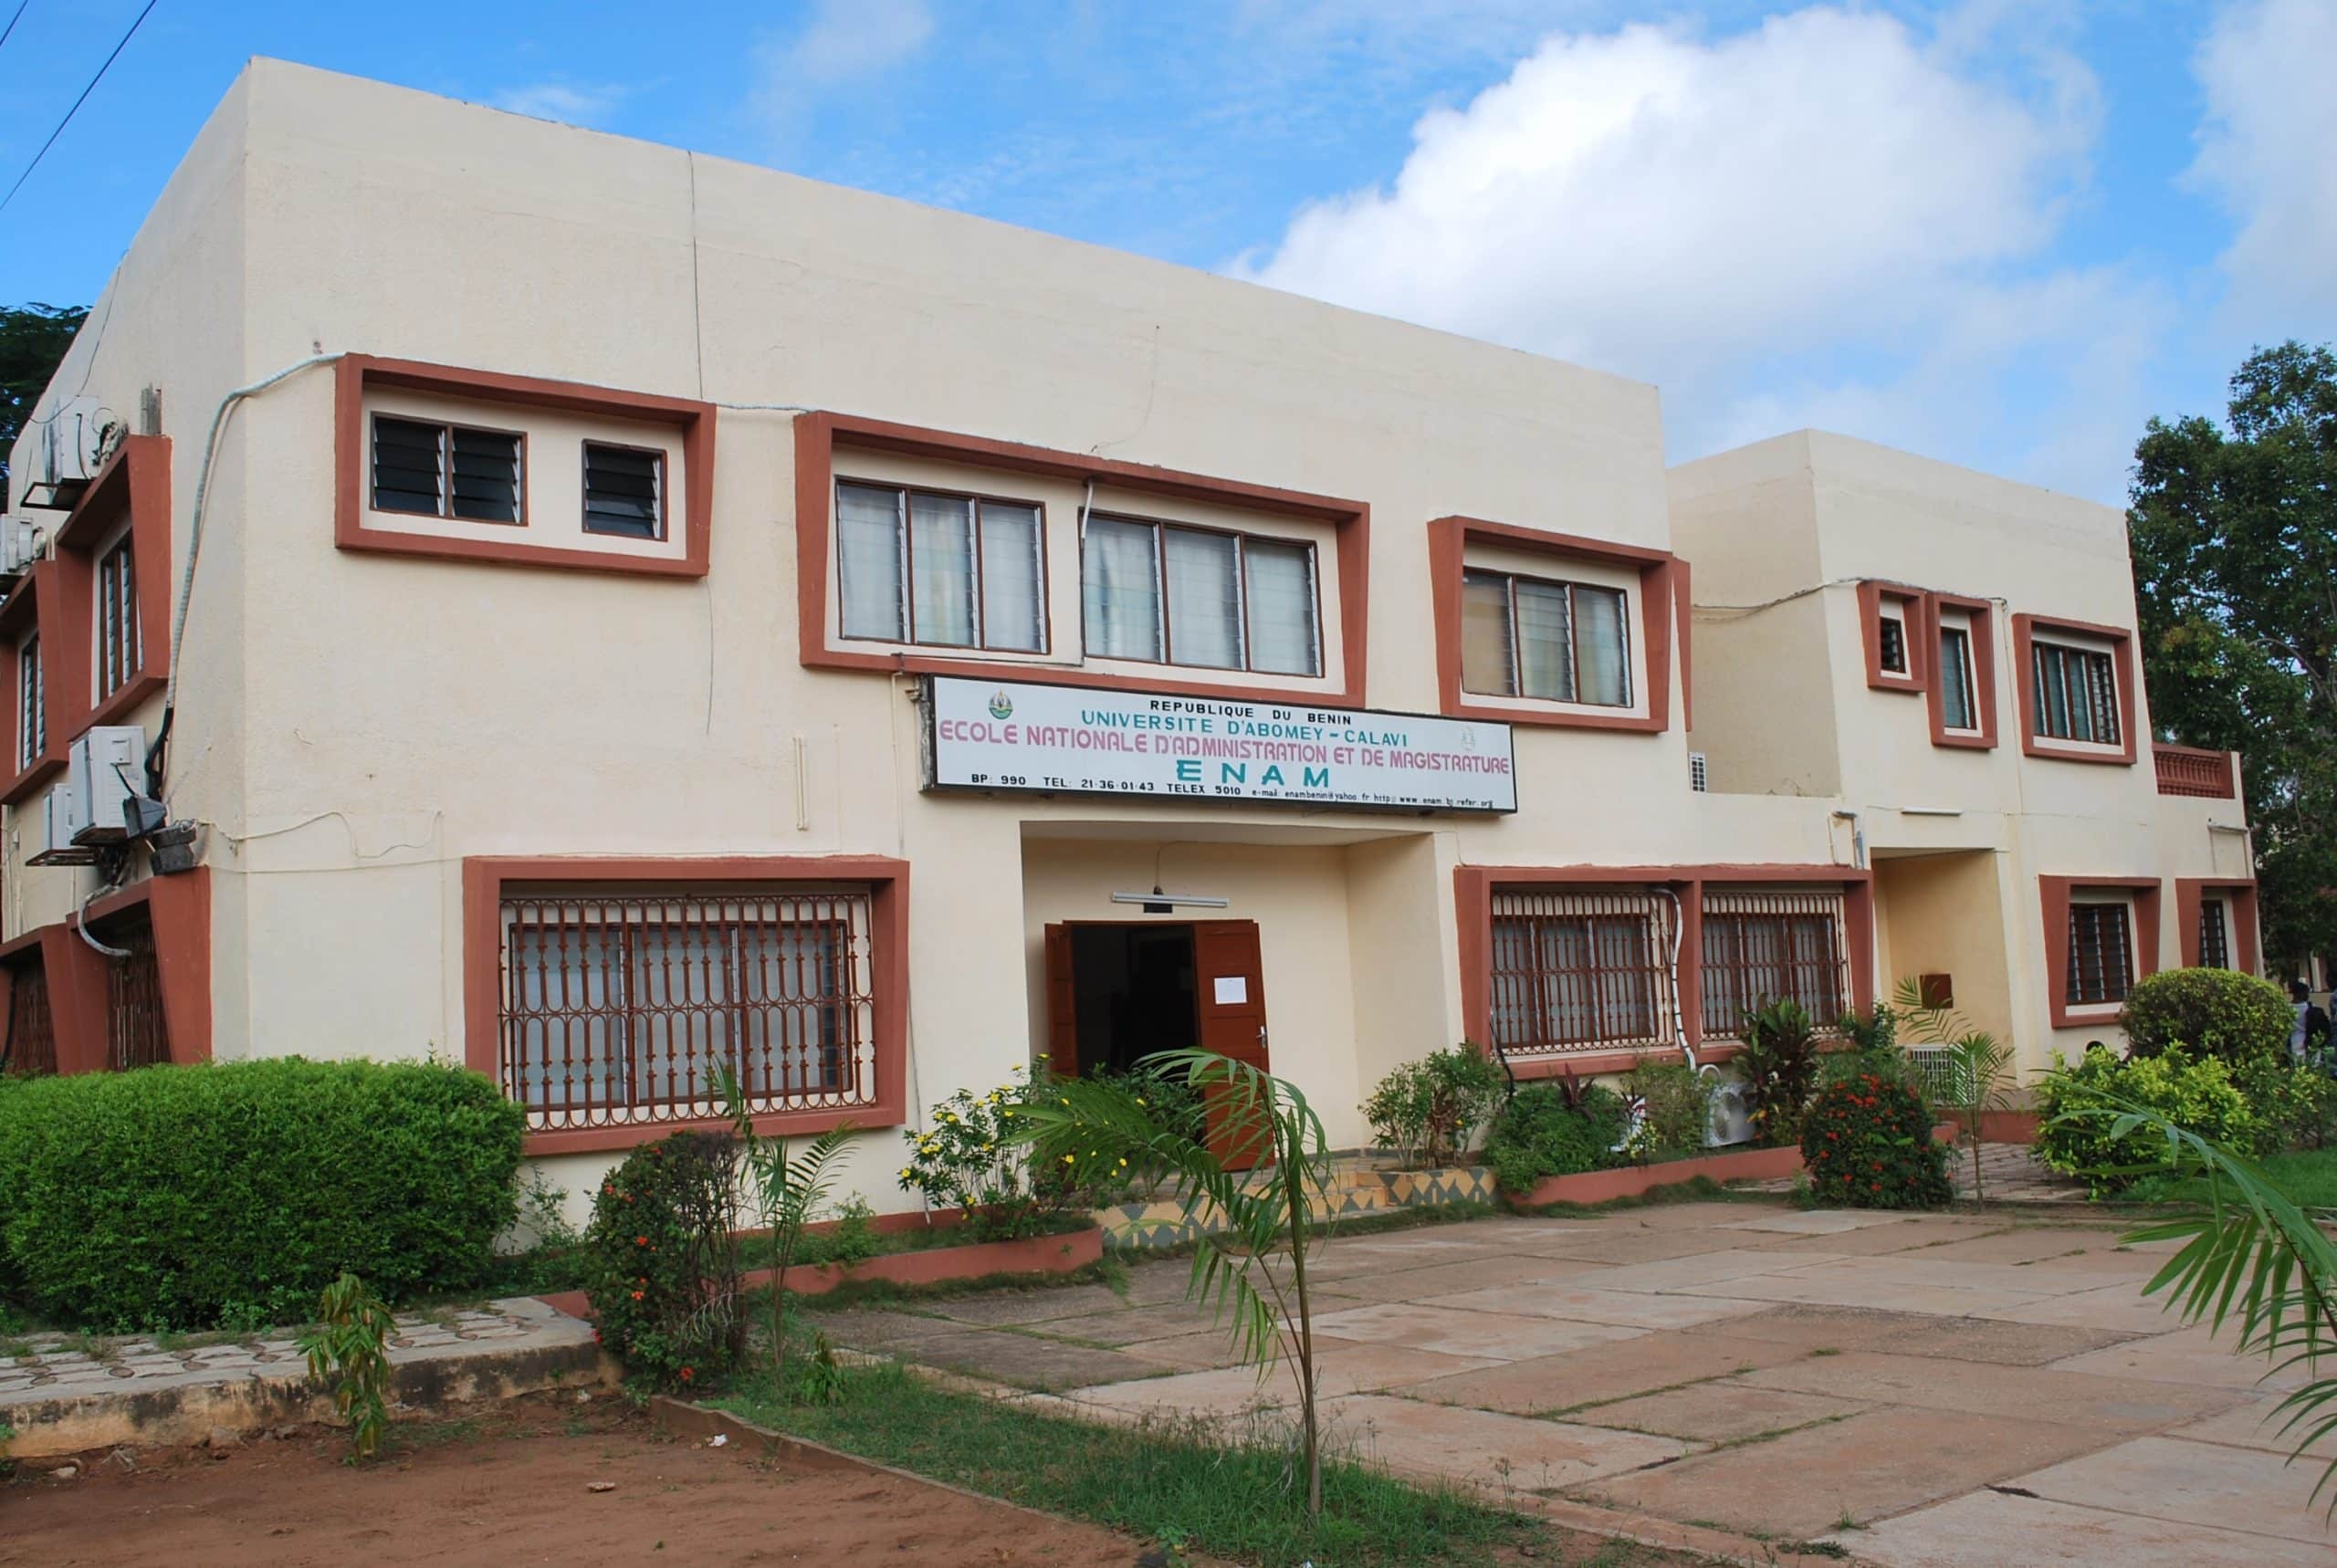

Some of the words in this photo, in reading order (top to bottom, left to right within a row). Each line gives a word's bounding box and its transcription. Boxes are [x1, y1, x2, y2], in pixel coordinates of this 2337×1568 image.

[1082, 710, 1212, 734] UNIVERSITE
[1150, 700, 1254, 717] REPUBLIQUE
[1273, 709, 1291, 721] DU
[1308, 713, 1351, 726] BENIN
[939, 719, 1018, 745] ECOLE
[1027, 726, 1148, 753] NATIONALE
[1155, 735, 1327, 763] D'ADMINISTRATION
[1334, 747, 1355, 766] ET
[1362, 749, 1384, 768] DE
[1390, 751, 1510, 775] MAGISTRATURE
[1001, 775, 1027, 786] 990
[1167, 783, 1205, 794] TELEX
[1215, 785, 1242, 796] 5010
[1176, 759, 1329, 788] ENAM
